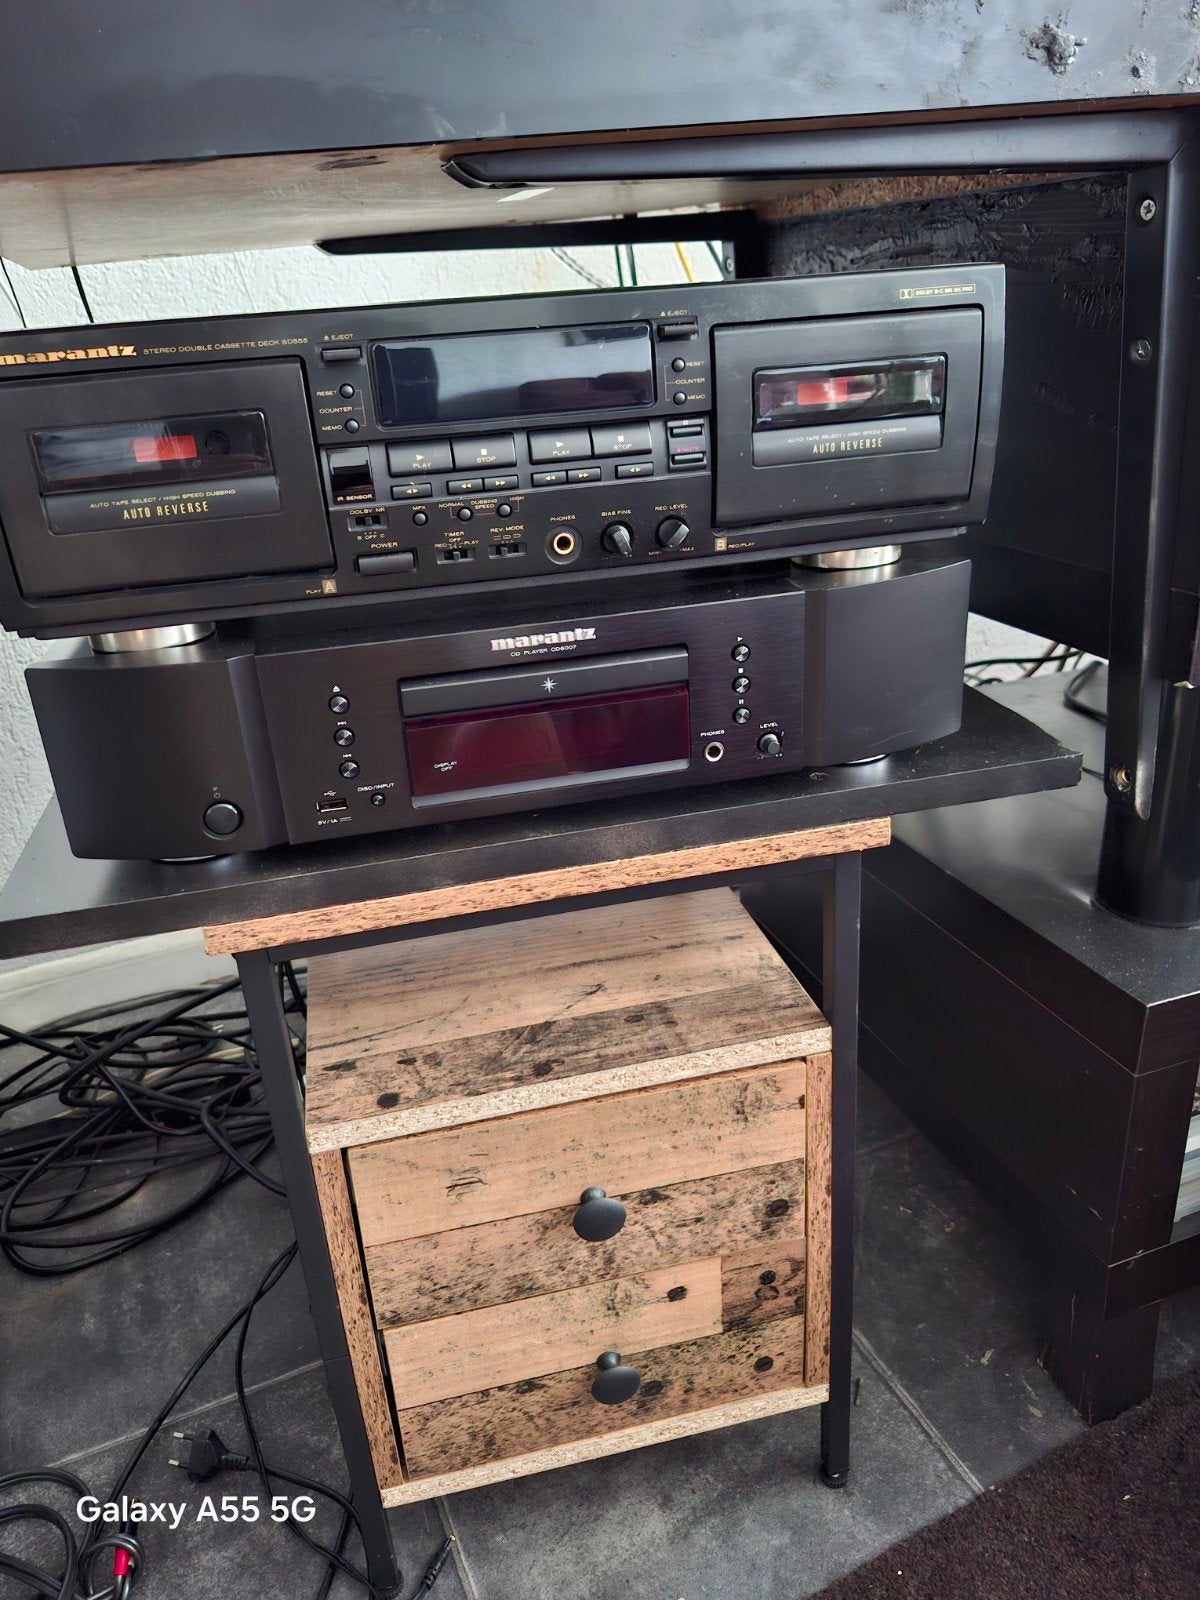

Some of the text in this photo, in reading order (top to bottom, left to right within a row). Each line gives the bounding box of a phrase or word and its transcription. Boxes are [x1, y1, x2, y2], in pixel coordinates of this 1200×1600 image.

[331, 333, 354, 342] EJECT
[0, 345, 137, 365] marantz
[143, 347, 177, 355] STEREO
[178, 344, 213, 353] DOUBLE
[214, 340, 256, 350] CASSETTE
[257, 339, 280, 347] DECK
[675, 377, 706, 386] COUNTER
[319, 406, 353, 414] COUNTER
[613, 442, 633, 451] STOP
[812, 437, 883, 455] AUTO REVERSE
[552, 449, 571, 457] PLAY
[476, 455, 497, 464] STOP
[89, 501, 110, 509] AUTO
[111, 499, 129, 507] TAPE
[131, 497, 158, 505] SELECT
[181, 492, 205, 500] SPEED
[205, 488, 237, 498] DUBBING
[345, 494, 373, 502] SENSOR
[470, 498, 498, 506] DUBBING
[438, 501, 465, 509] NORMAL
[123, 500, 210, 520] AUTO REVERSE
[350, 508, 373, 516] DOLBY
[550, 514, 576, 522] PHONES
[505, 524, 525, 533] MODE
[444, 530, 465, 538] TIMER
[370, 541, 399, 550] POWER
[490, 627, 597, 651] marantz
[700, 729, 725, 737] PHONES
[434, 760, 458, 769] DISPLAY
[357, 782, 395, 792] DISC/INPUT
